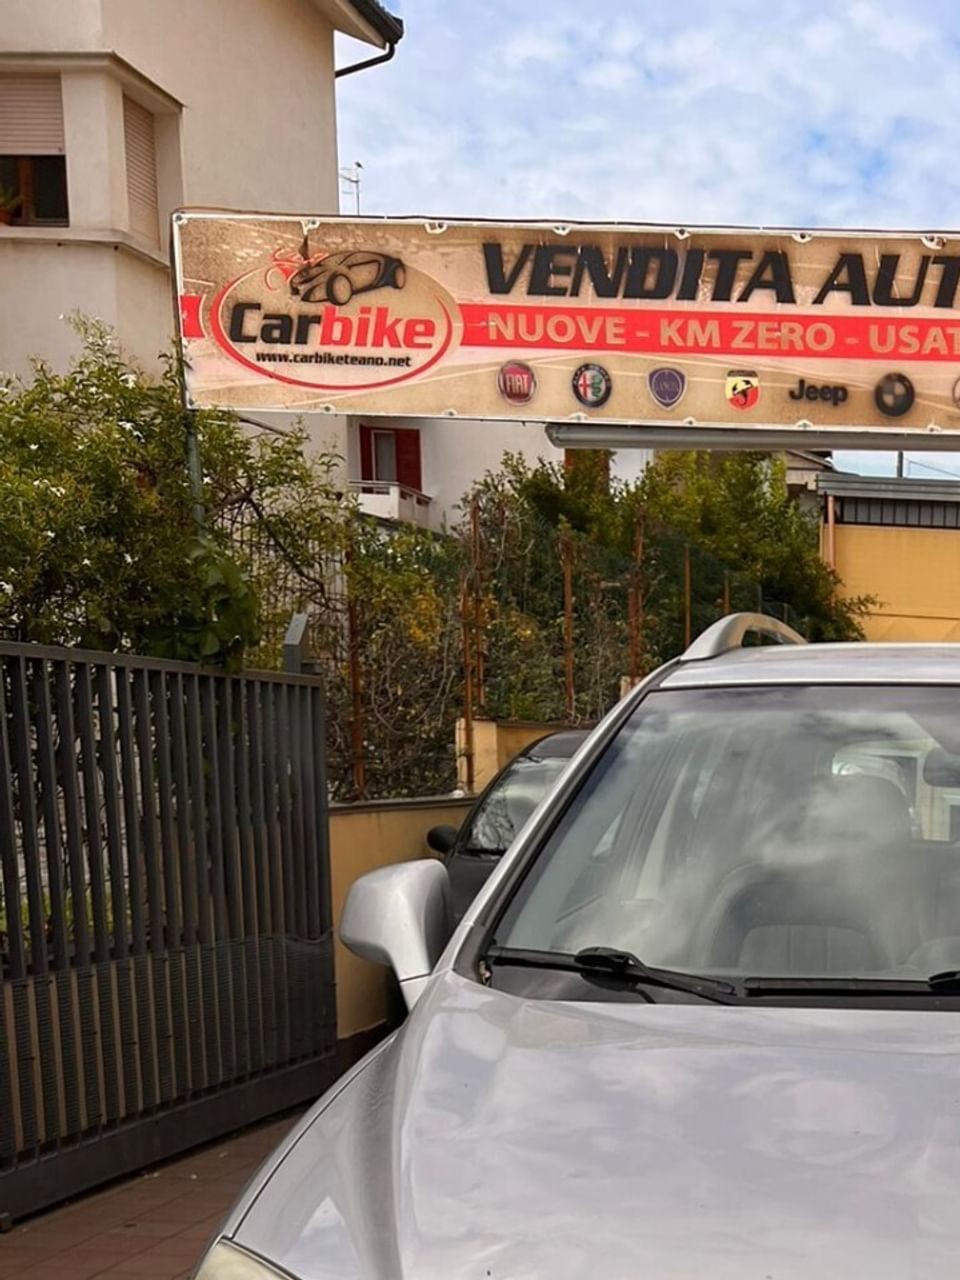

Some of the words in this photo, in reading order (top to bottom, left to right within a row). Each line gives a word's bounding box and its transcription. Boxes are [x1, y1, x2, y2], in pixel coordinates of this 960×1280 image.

[481, 242, 797, 305] VENDITA
[229, 302, 436, 349] Carbike
[488, 311, 627, 345] NUOVE
[659, 317, 722, 348] KM
[730, 320, 836, 352] ZERO
[256, 351, 412, 367] www.carbiketeano.net
[505, 374, 529, 394] FIAT
[788, 379, 848, 406] Jeep
